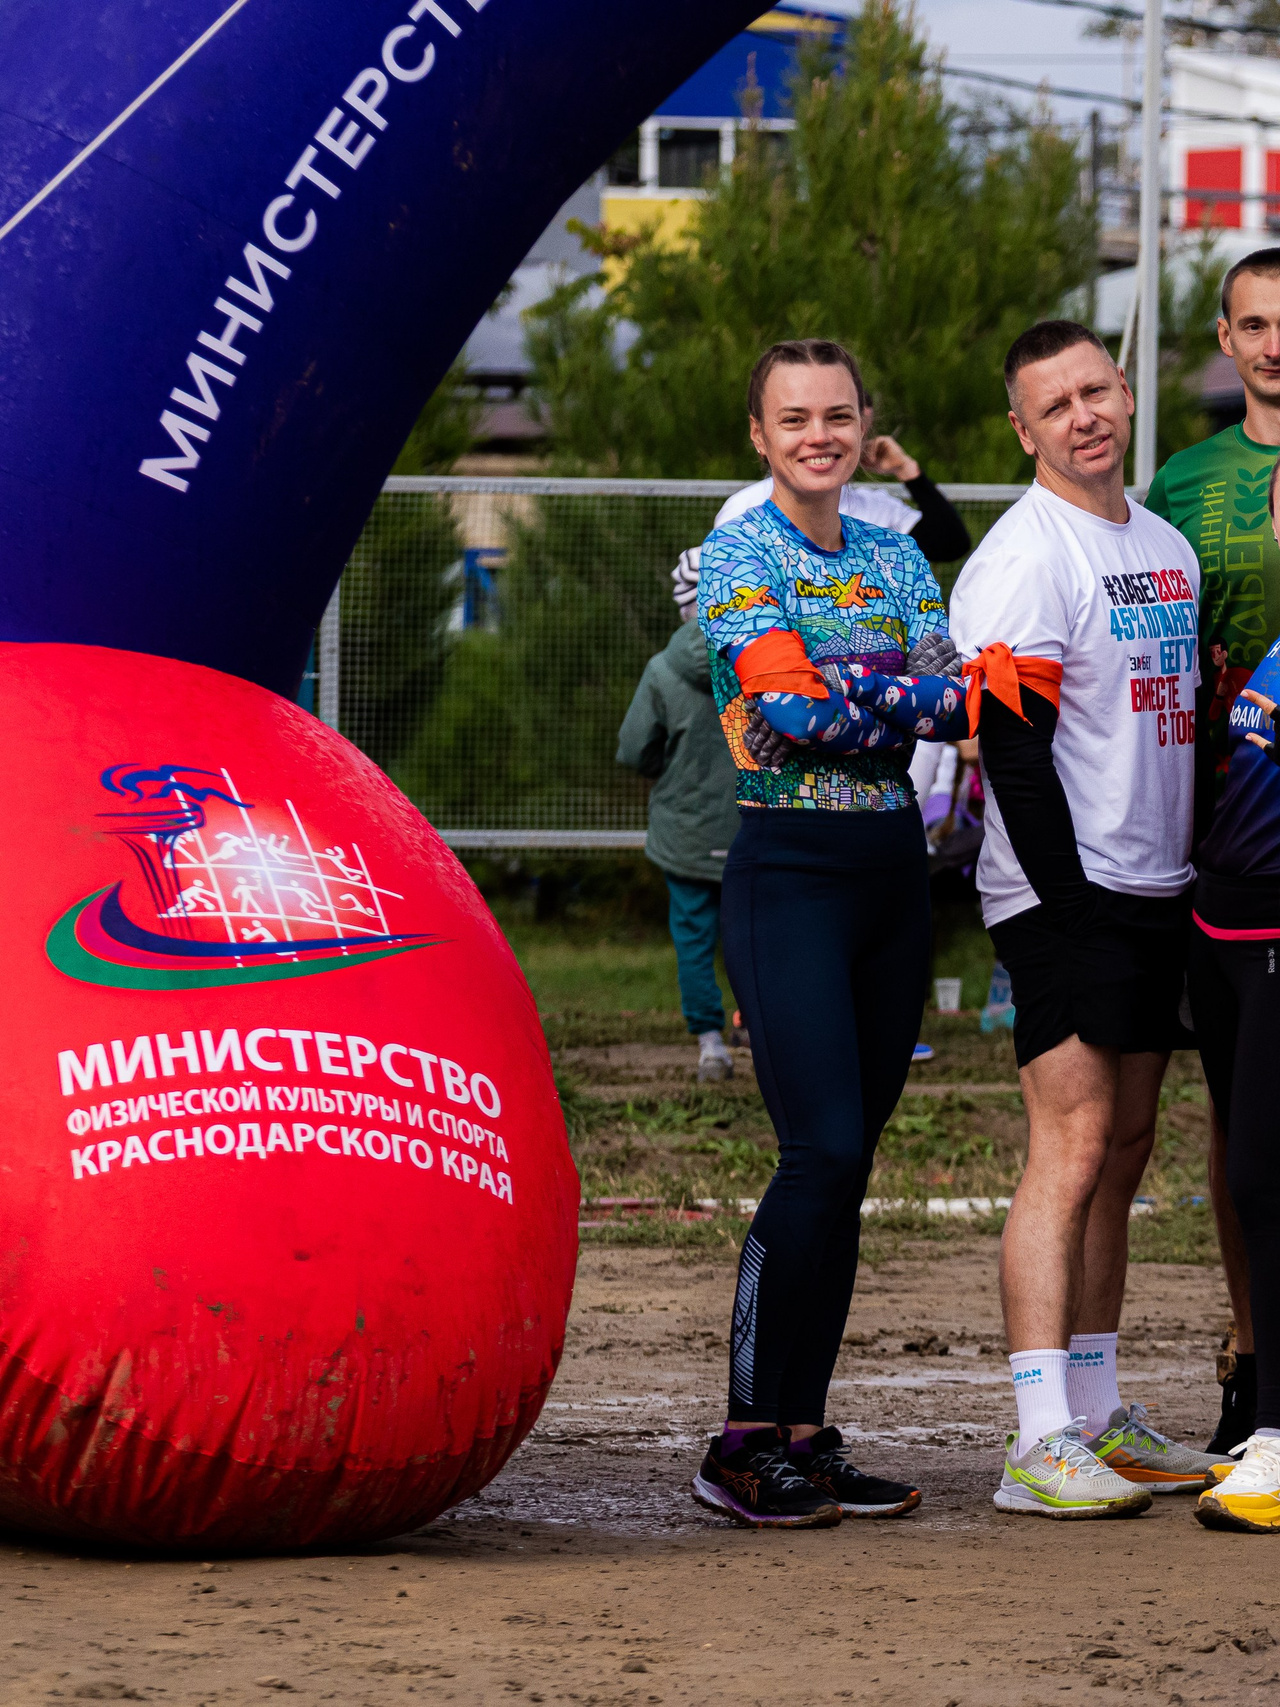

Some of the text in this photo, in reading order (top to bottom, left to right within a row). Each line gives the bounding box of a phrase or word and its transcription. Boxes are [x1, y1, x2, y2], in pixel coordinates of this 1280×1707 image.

[138, 0, 490, 492] МИНИСТЕРСТ
[1224, 522, 1268, 664] ЗАБЕГ
[1130, 675, 1180, 713] ВМЕСТЕ
[1160, 637, 1197, 675] БЕГУ
[1157, 712, 1167, 748] С
[57, 1027, 502, 1119] МИНИСТЕРСТВО
[66, 1081, 509, 1163] ФИЗИЧЕСКОЙ КУЛЬТУРЫ И СПОРТА
[70, 1122, 514, 1205] КРАСНОДАРСКОГО КРАЯ
